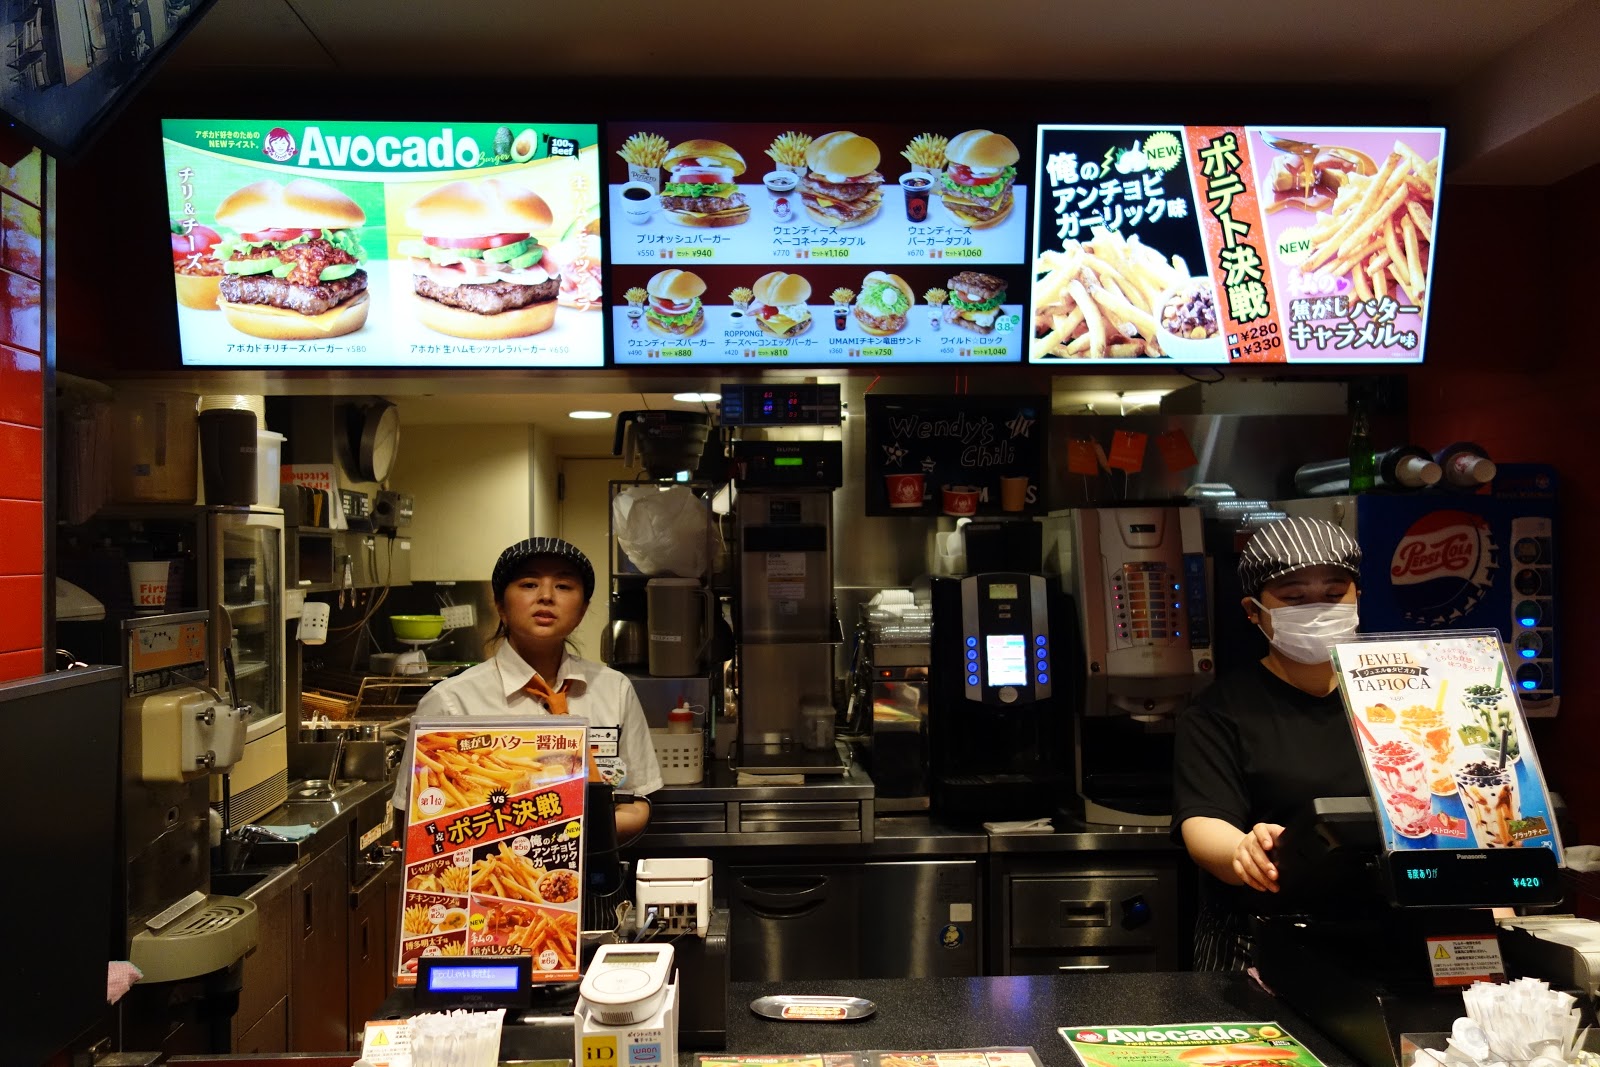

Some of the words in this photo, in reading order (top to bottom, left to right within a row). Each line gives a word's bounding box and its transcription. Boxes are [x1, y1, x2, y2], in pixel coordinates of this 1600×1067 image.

[298, 126, 480, 168] Avocado
[552, 138, 574, 148] 100%
[552, 146, 573, 156] Beef
[1147, 145, 1178, 160] NEW
[476, 151, 510, 168] Burger
[1046, 152, 1100, 187] 俺の
[1052, 168, 1165, 214] アンチョビ
[1056, 198, 1188, 239] ガーリック味
[1200, 133, 1270, 323] ポテト決戦
[637, 234, 730, 244] ブリオッシュバーガー
[908, 237, 972, 246] バーガーダブル
[692, 250, 712, 258] ¥940
[824, 250, 848, 258] ¥1,160
[958, 250, 982, 258] ¥1,060
[1279, 240, 1312, 254] NEW
[1290, 296, 1420, 322] 焦がしバター
[829, 337, 922, 345] UMAMIチキン竜田サンド
[1228, 334, 1238, 345] M
[1240, 323, 1278, 341] ¥280
[1290, 320, 1417, 350] キャラメル味
[226, 344, 343, 354] アボカドチリチーズバーガー
[984, 348, 1006, 356] ¥1,040
[1244, 336, 1281, 354] ¥330
[888, 412, 994, 444] Wendy's
[960, 440, 1015, 467] Chili
[1025, 485, 1038, 504] S
[1357, 652, 1414, 668] JEWEL
[1353, 678, 1432, 692] TAPIOCA
[459, 734, 578, 750] 焦がしバター醤油味
[420, 794, 442, 806] 第1位
[492, 796, 504, 804] VS
[448, 792, 562, 844] ポテト決戦
[1433, 826, 1466, 836] ストロベリー
[1512, 827, 1548, 840] ブラックティー
[426, 824, 444, 854] 下克上
[530, 834, 550, 848] 俺の
[532, 840, 577, 858] アンチョビ
[1512, 878, 1539, 888] ¥420
[470, 932, 494, 944] 私の
[1107, 1027, 1250, 1043] Avocado
[586, 1046, 614, 1060] iD
